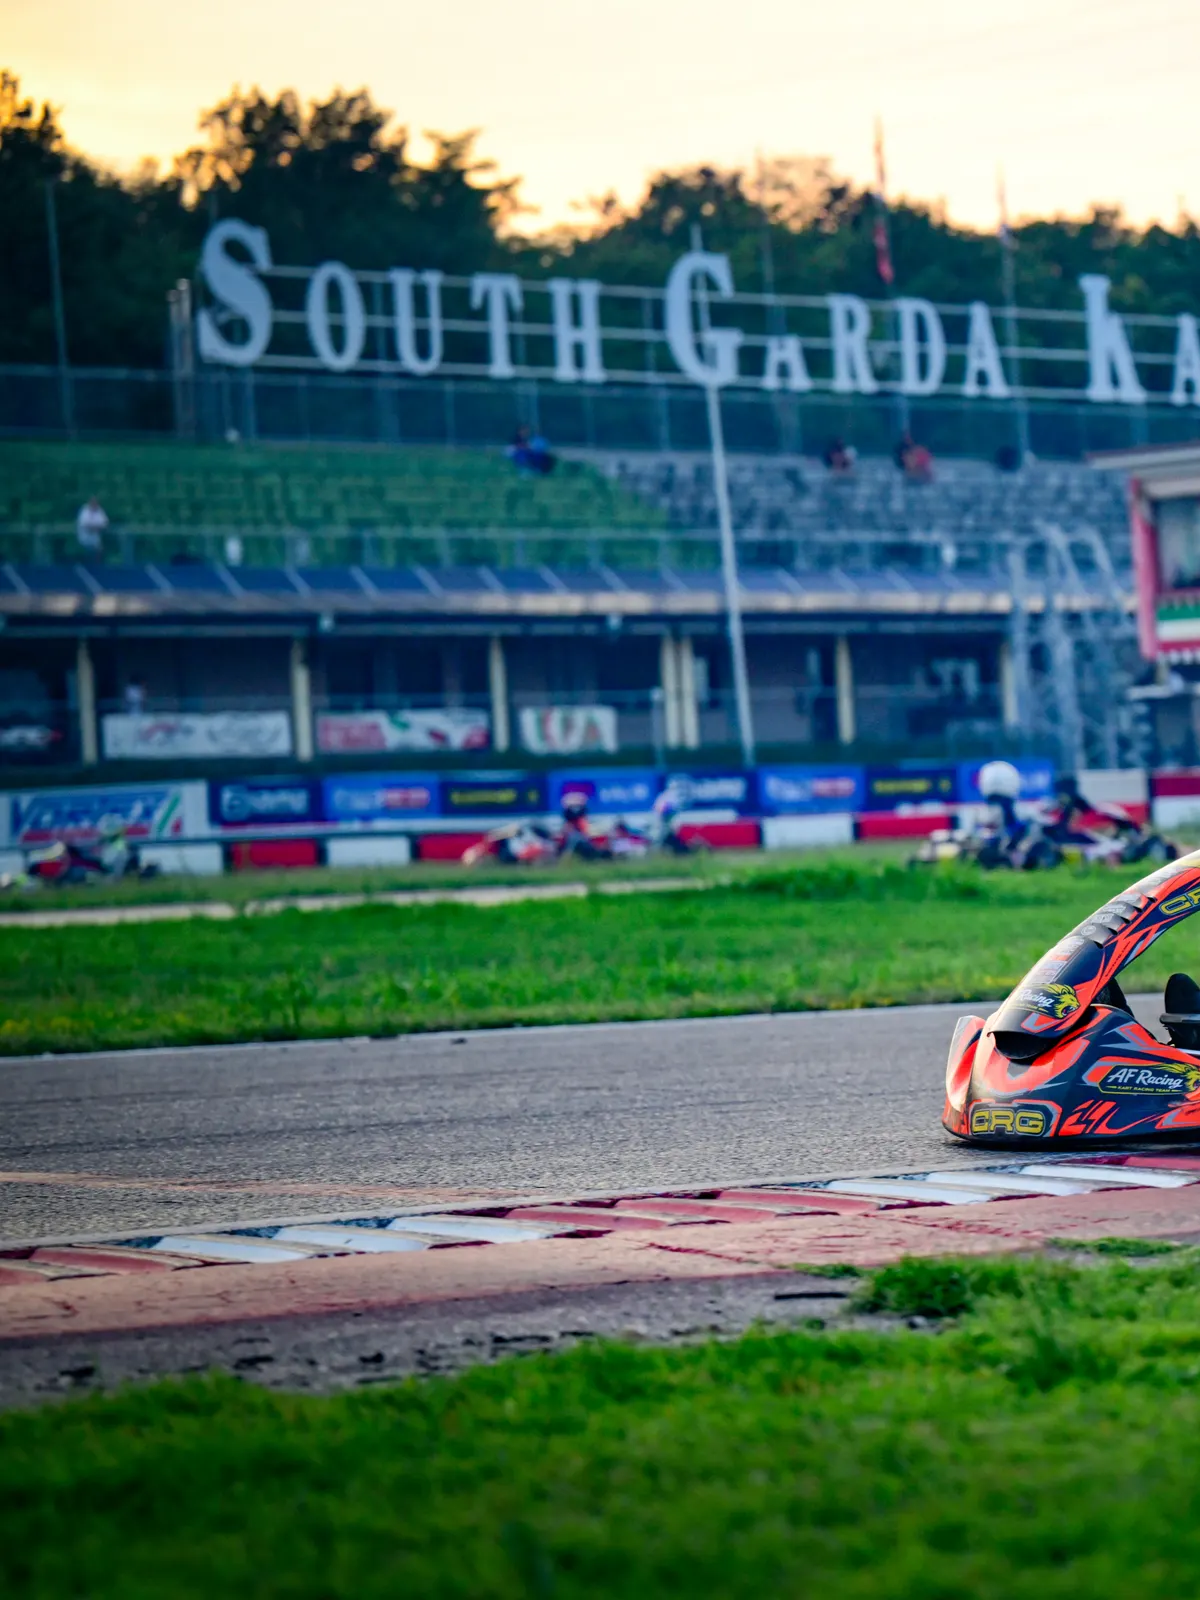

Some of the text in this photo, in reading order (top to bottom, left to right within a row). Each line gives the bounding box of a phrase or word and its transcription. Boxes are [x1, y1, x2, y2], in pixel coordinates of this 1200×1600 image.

[199, 217, 606, 383] SOUTH
[665, 251, 1010, 399] GARDA
[1107, 1068, 1184, 1089] AF Racing
[972, 1109, 1045, 1135] CRG
